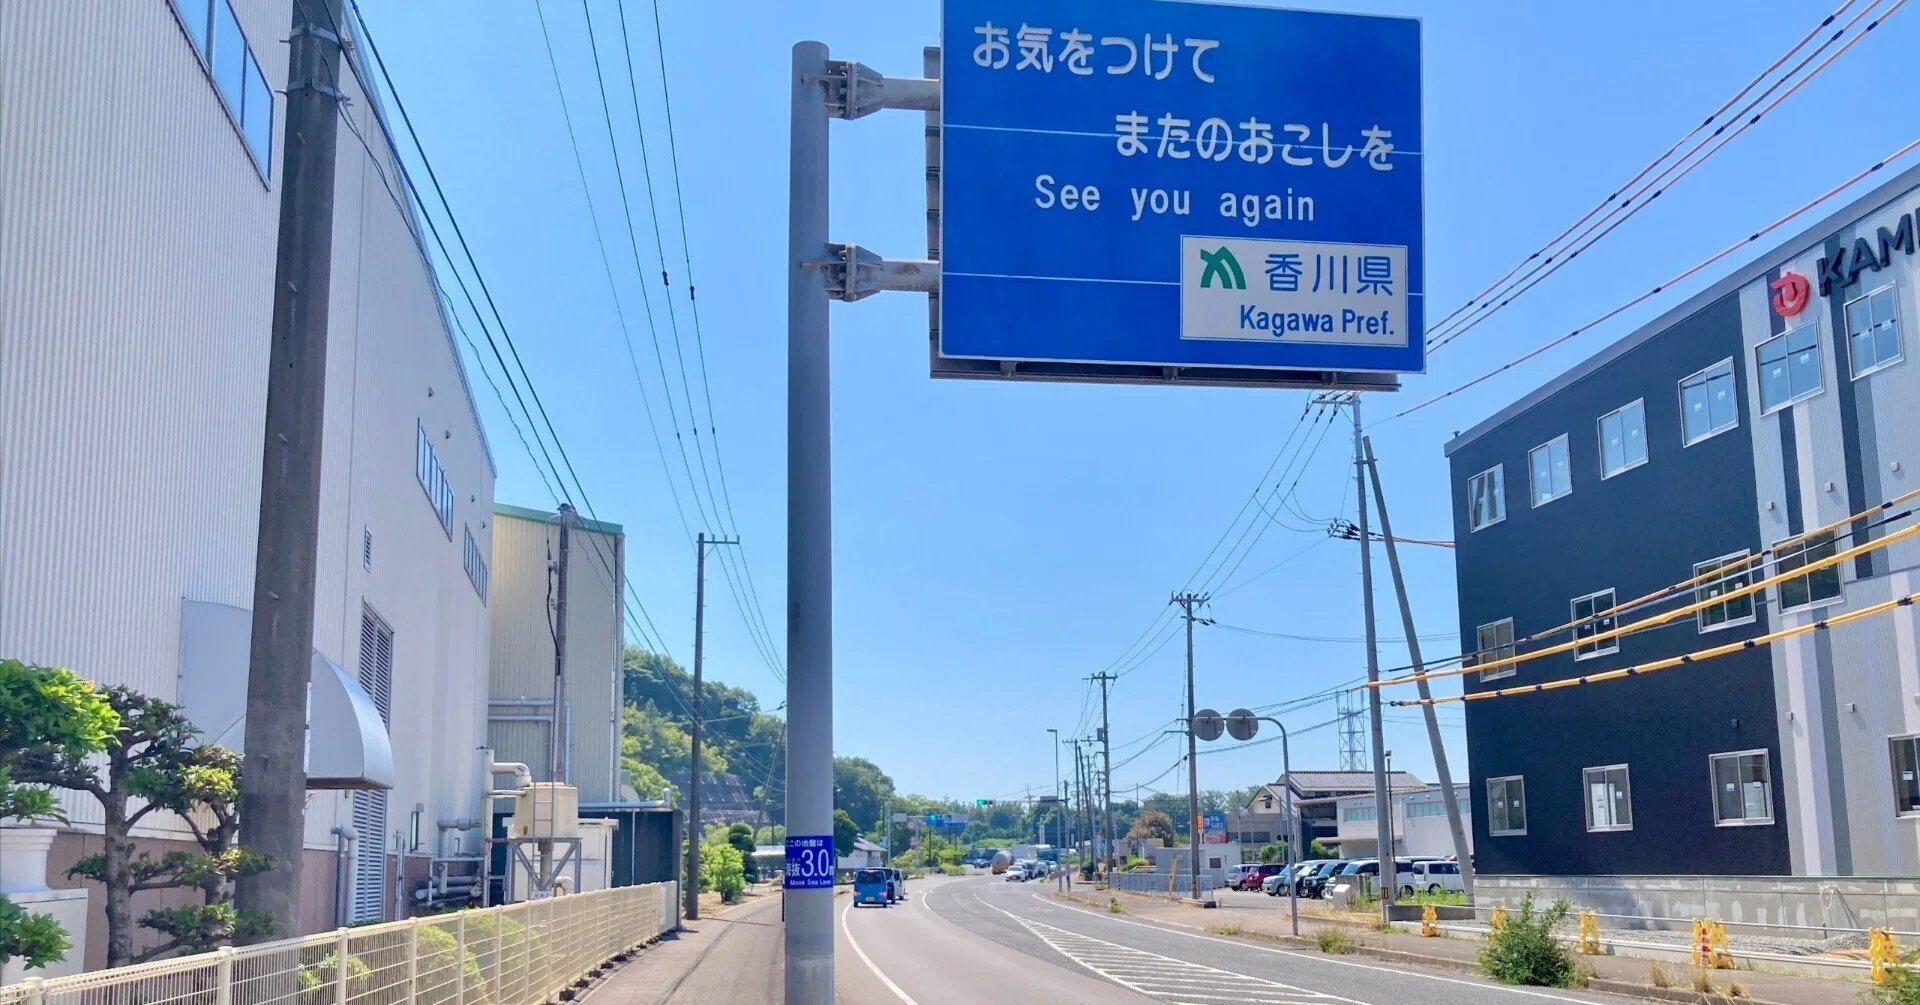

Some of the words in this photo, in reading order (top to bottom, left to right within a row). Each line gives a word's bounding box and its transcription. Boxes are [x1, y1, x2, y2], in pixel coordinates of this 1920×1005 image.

[973, 21, 1220, 83] お気をつけて
[1115, 110, 1395, 171] またのおこしを
[1035, 175, 1100, 211] See
[1131, 188, 1190, 221] you
[1220, 188, 1314, 227] again
[1264, 254, 1394, 297] 香川県
[1816, 207, 1920, 297] KAM
[1239, 305, 1334, 337] Kagawa
[1342, 309, 1395, 336] Pref.
